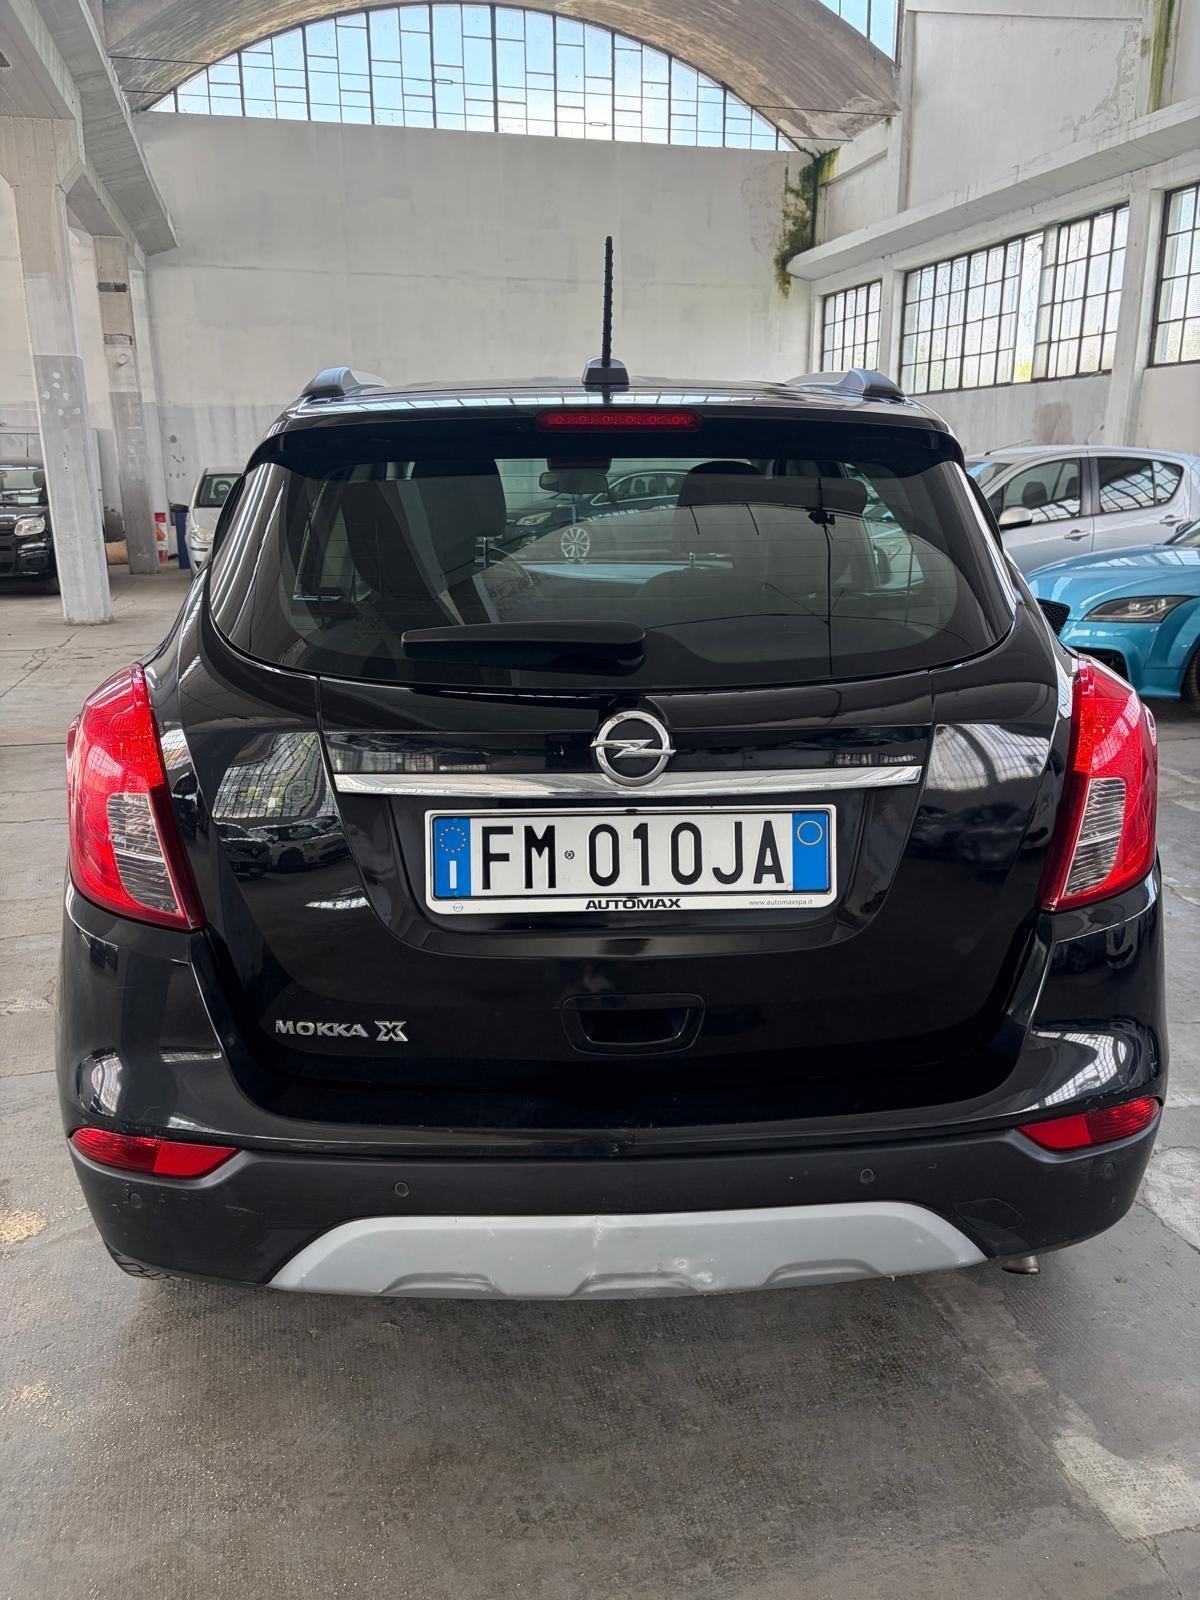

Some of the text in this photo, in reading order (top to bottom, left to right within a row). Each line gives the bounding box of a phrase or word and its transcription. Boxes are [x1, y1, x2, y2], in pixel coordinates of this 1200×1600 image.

[585, 898, 682, 910] AUTOMAX
[748, 898, 813, 907] www.automaxspa.it
[275, 1019, 409, 1042] MOKKA X
